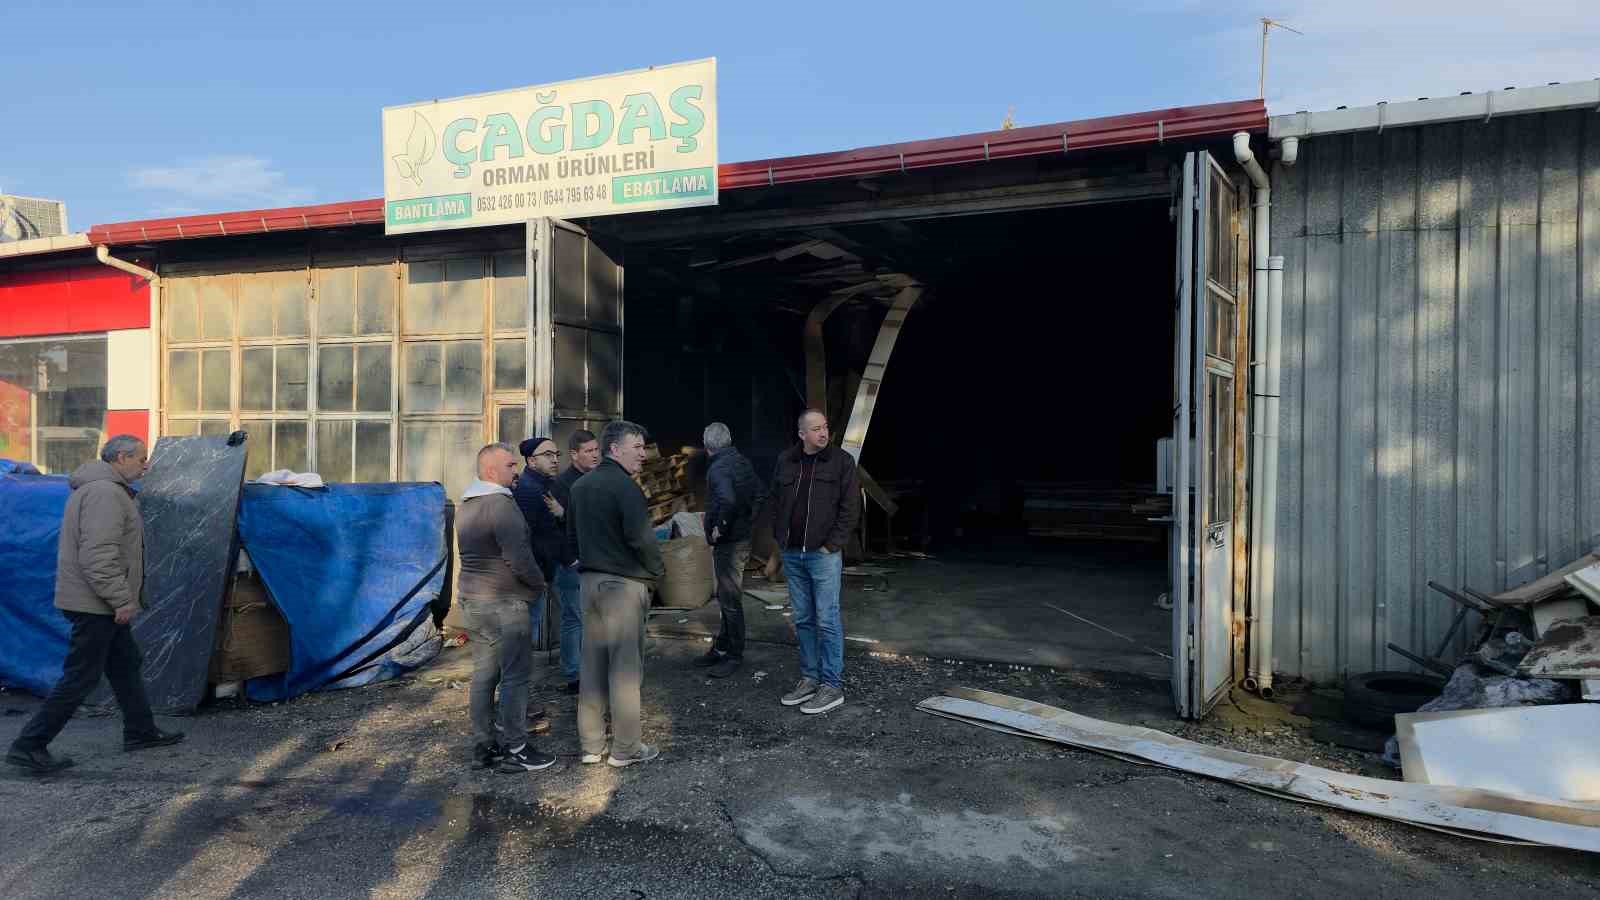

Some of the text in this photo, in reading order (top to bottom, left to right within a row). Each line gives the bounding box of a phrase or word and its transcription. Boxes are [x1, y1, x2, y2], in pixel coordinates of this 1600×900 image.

[442, 85, 706, 179] ÇAĞDAŞ
[482, 145, 655, 187] ORMAN ÜRÜNLERİ
[477, 195, 496, 212] 0532
[514, 192, 526, 208] 00
[527, 191, 537, 208] 73
[543, 187, 563, 206] 0544
[583, 185, 594, 201] 63
[596, 184, 607, 200] 48
[623, 174, 708, 198] EBATLAMA
[395, 199, 465, 221] BANTLAMA
